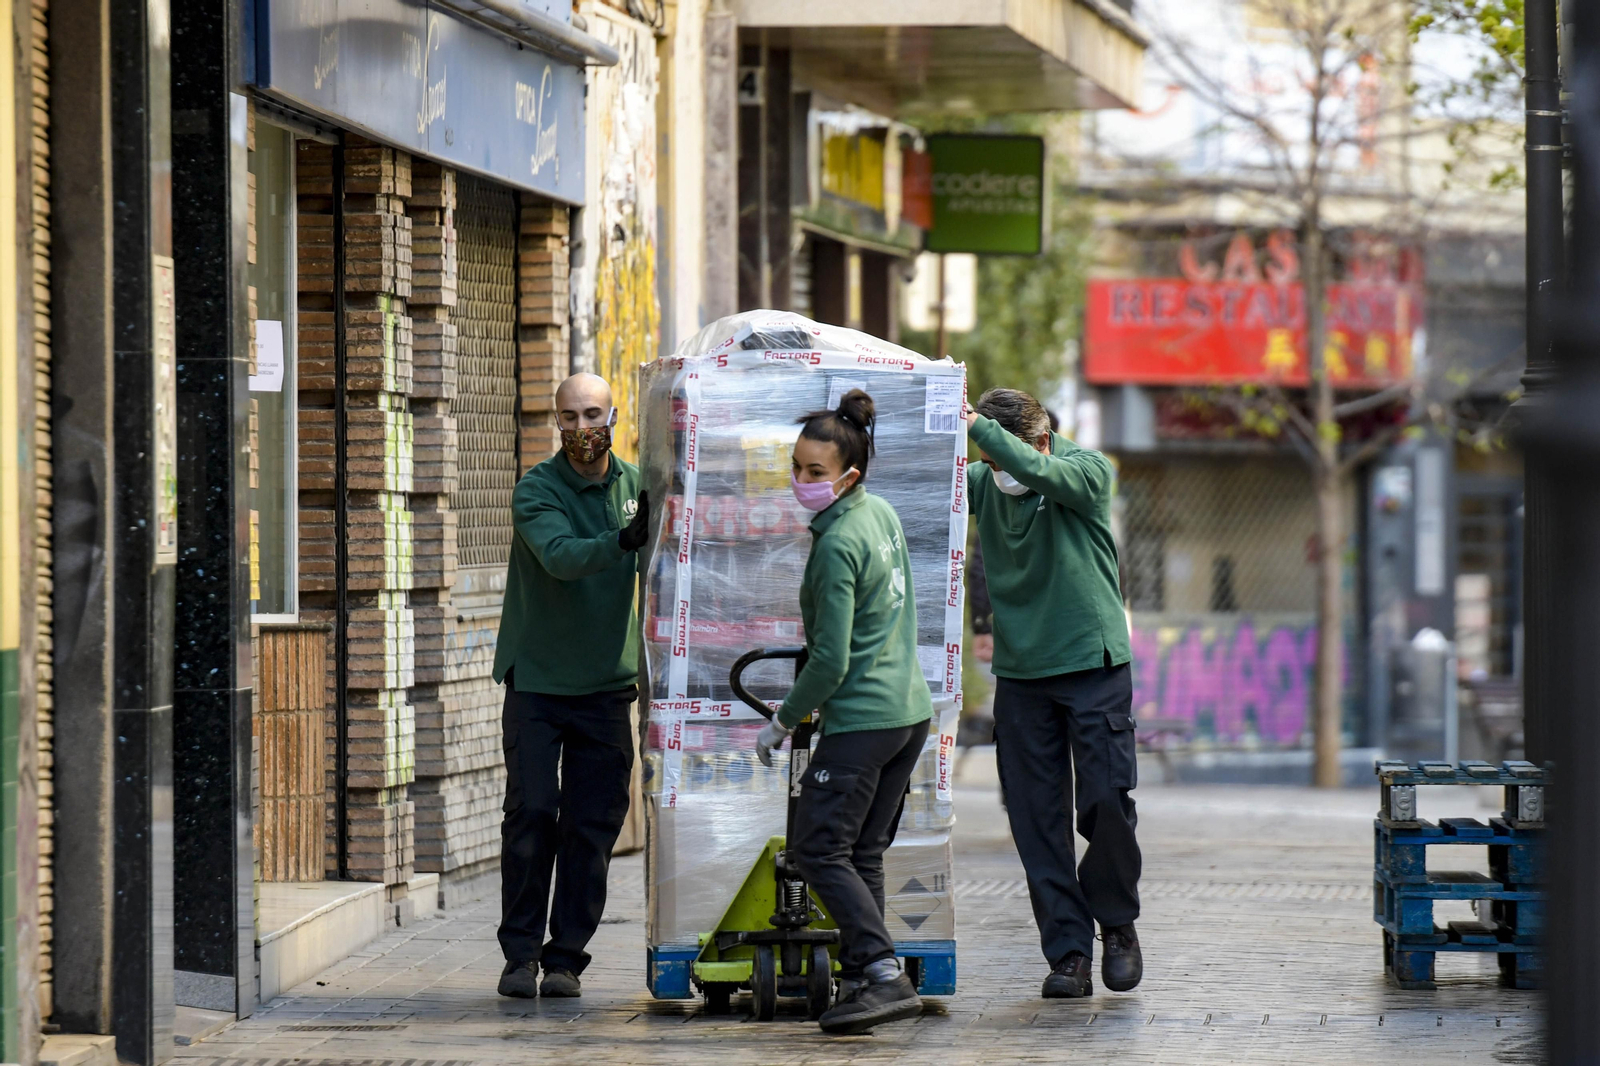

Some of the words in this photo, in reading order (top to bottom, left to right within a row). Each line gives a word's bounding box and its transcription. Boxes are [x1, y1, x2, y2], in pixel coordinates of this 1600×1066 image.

[931, 169, 1040, 198] codere
[764, 351, 822, 365] FACTOR5
[857, 355, 915, 371] FACTOR5
[952, 456, 968, 514] FACTOR5
[948, 549, 964, 607] FACTOR5
[673, 599, 689, 658] FACTOR5
[945, 642, 960, 693] ACTOR5
[938, 733, 954, 791] FACTOR5
